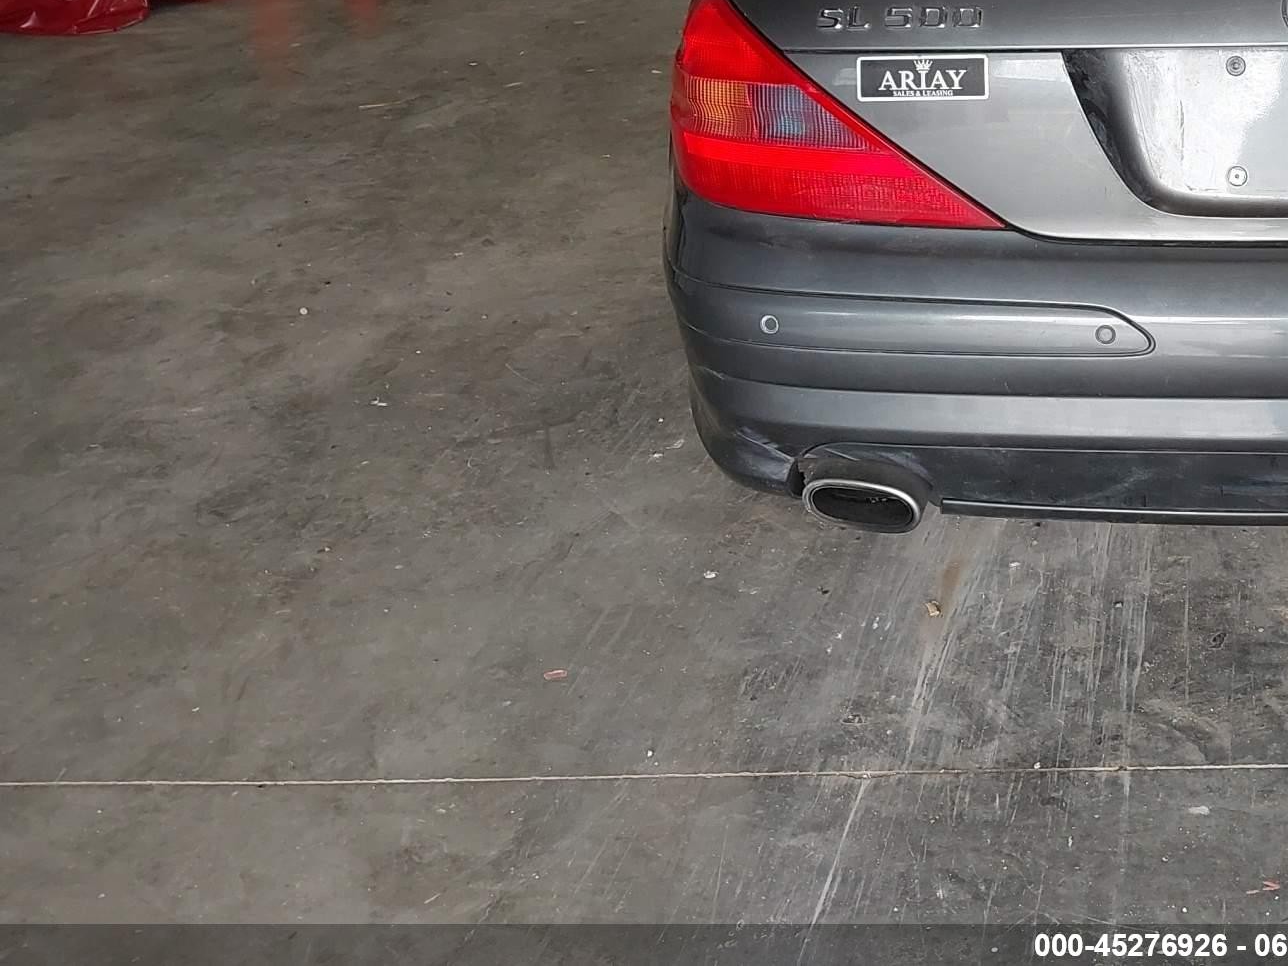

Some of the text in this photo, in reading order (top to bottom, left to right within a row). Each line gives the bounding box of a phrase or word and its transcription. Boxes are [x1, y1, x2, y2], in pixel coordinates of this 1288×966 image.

[816, 6, 983, 31] SL 500
[922, 89, 953, 97] LEASING
